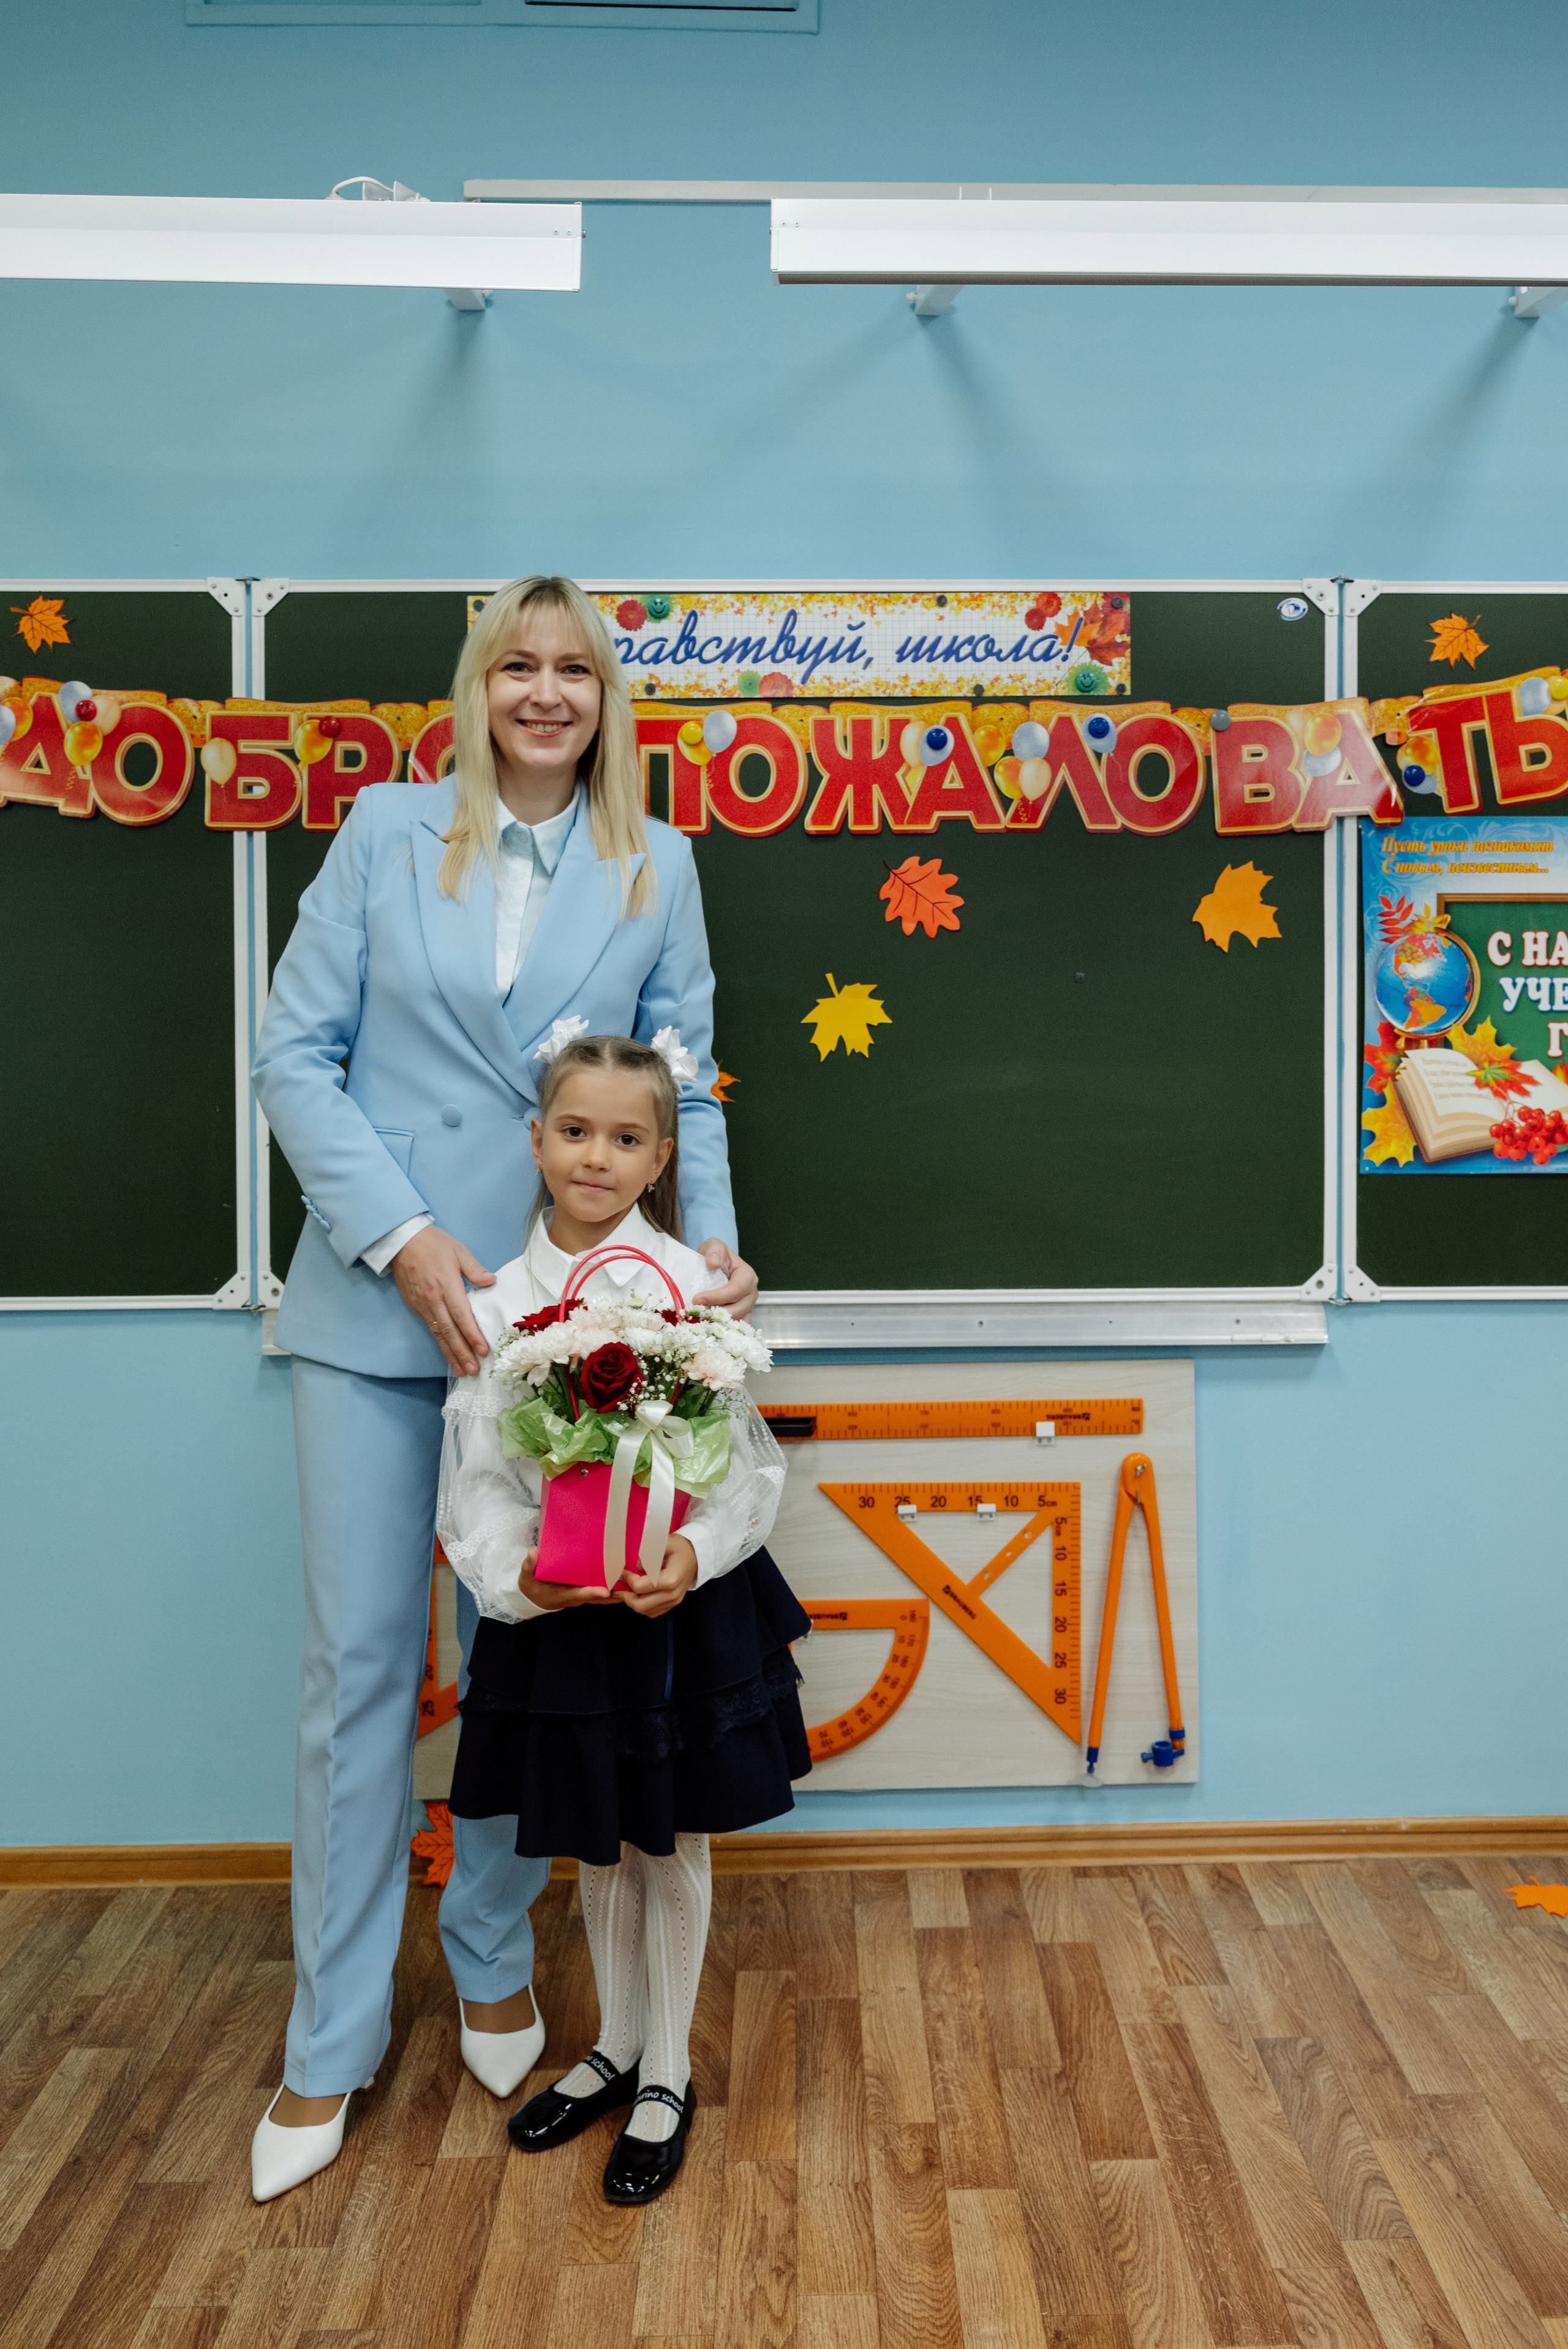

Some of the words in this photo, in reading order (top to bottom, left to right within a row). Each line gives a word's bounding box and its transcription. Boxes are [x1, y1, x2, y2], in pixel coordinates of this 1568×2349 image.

[895, 617, 1084, 663] школа!
[1381, 837, 1426, 856] Пусть
[1428, 841, 1468, 856] уроки
[1472, 841, 1554, 852] познакомят
[1381, 858, 1393, 873] С
[1395, 862, 1444, 876] новым,
[1487, 930, 1512, 966] С
[859, 1496, 875, 1508] 30
[930, 1496, 947, 1507] 20
[968, 1495, 983, 1507] 15
[1005, 1495, 1019, 1507] 10
[1055, 1546, 1067, 1561] 10
[1055, 1582, 1067, 1596] 15
[1055, 1617, 1067, 1632] 20
[1055, 1653, 1067, 1668] 25
[1055, 1688, 1066, 1705] 30
[591, 2058, 616, 2081] school
[662, 2094, 684, 2114] school
